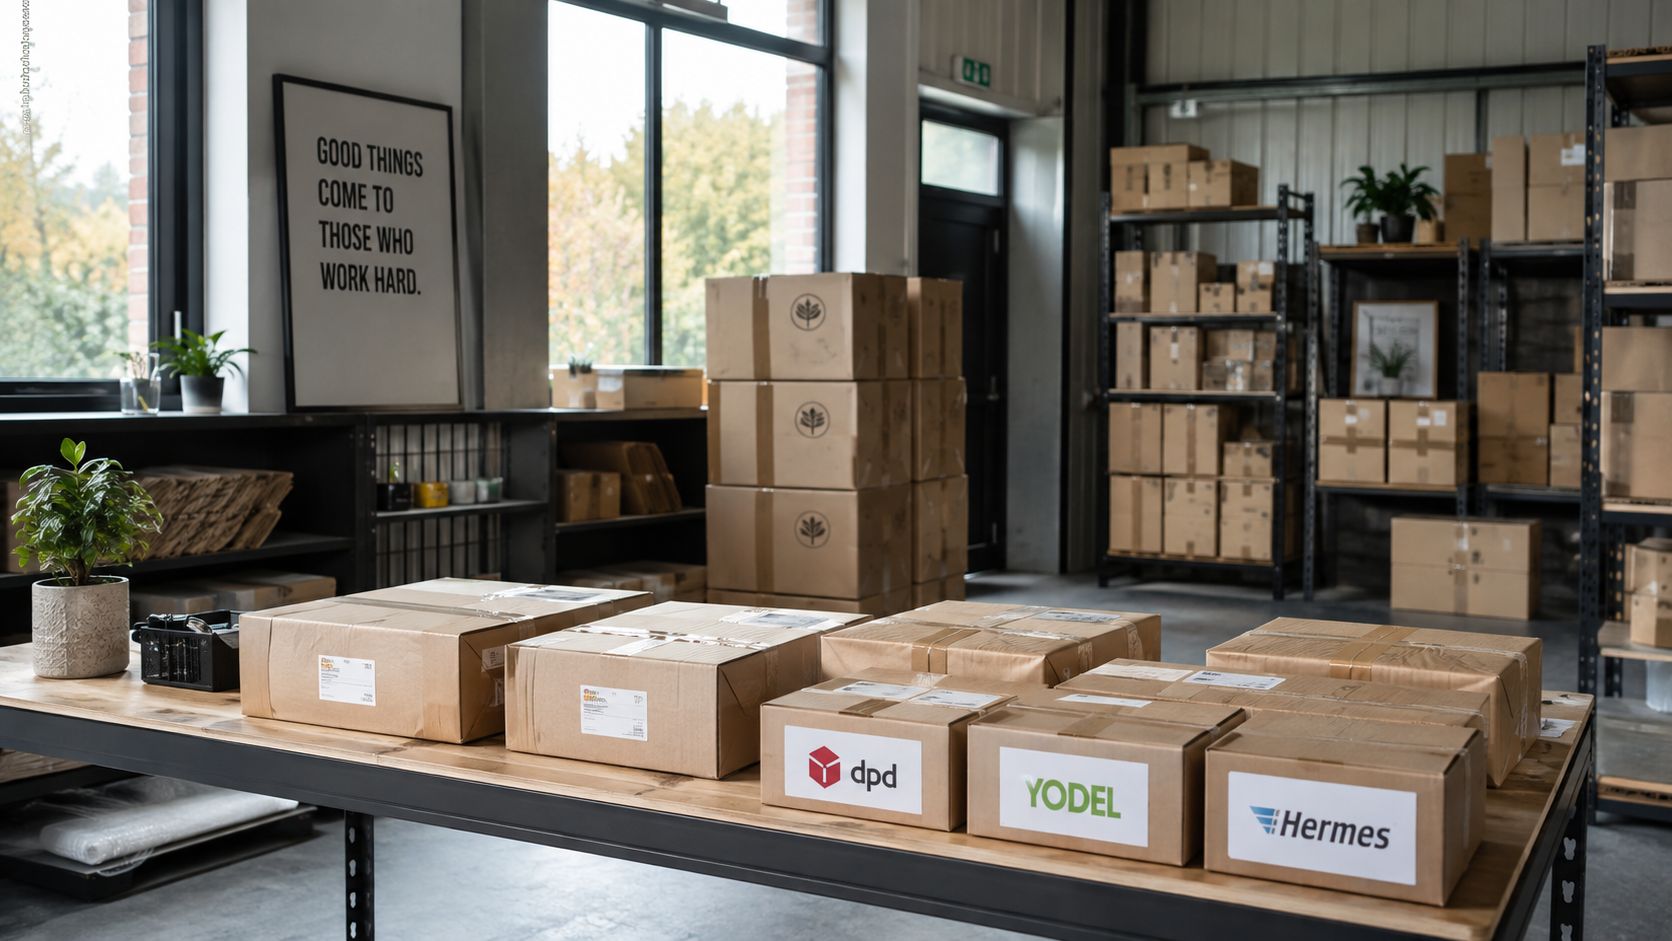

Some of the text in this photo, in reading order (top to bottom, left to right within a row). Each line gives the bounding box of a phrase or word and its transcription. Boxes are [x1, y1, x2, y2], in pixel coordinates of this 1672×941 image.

[317, 136, 423, 177] GOOD THINGS
[318, 178, 394, 214] COME TO
[318, 220, 414, 255] THOSE WHO
[320, 262, 421, 295] WORK HARD.
[850, 759, 897, 792] dpd
[1025, 776, 1121, 819] YODEL
[1279, 810, 1391, 849] Hermes
